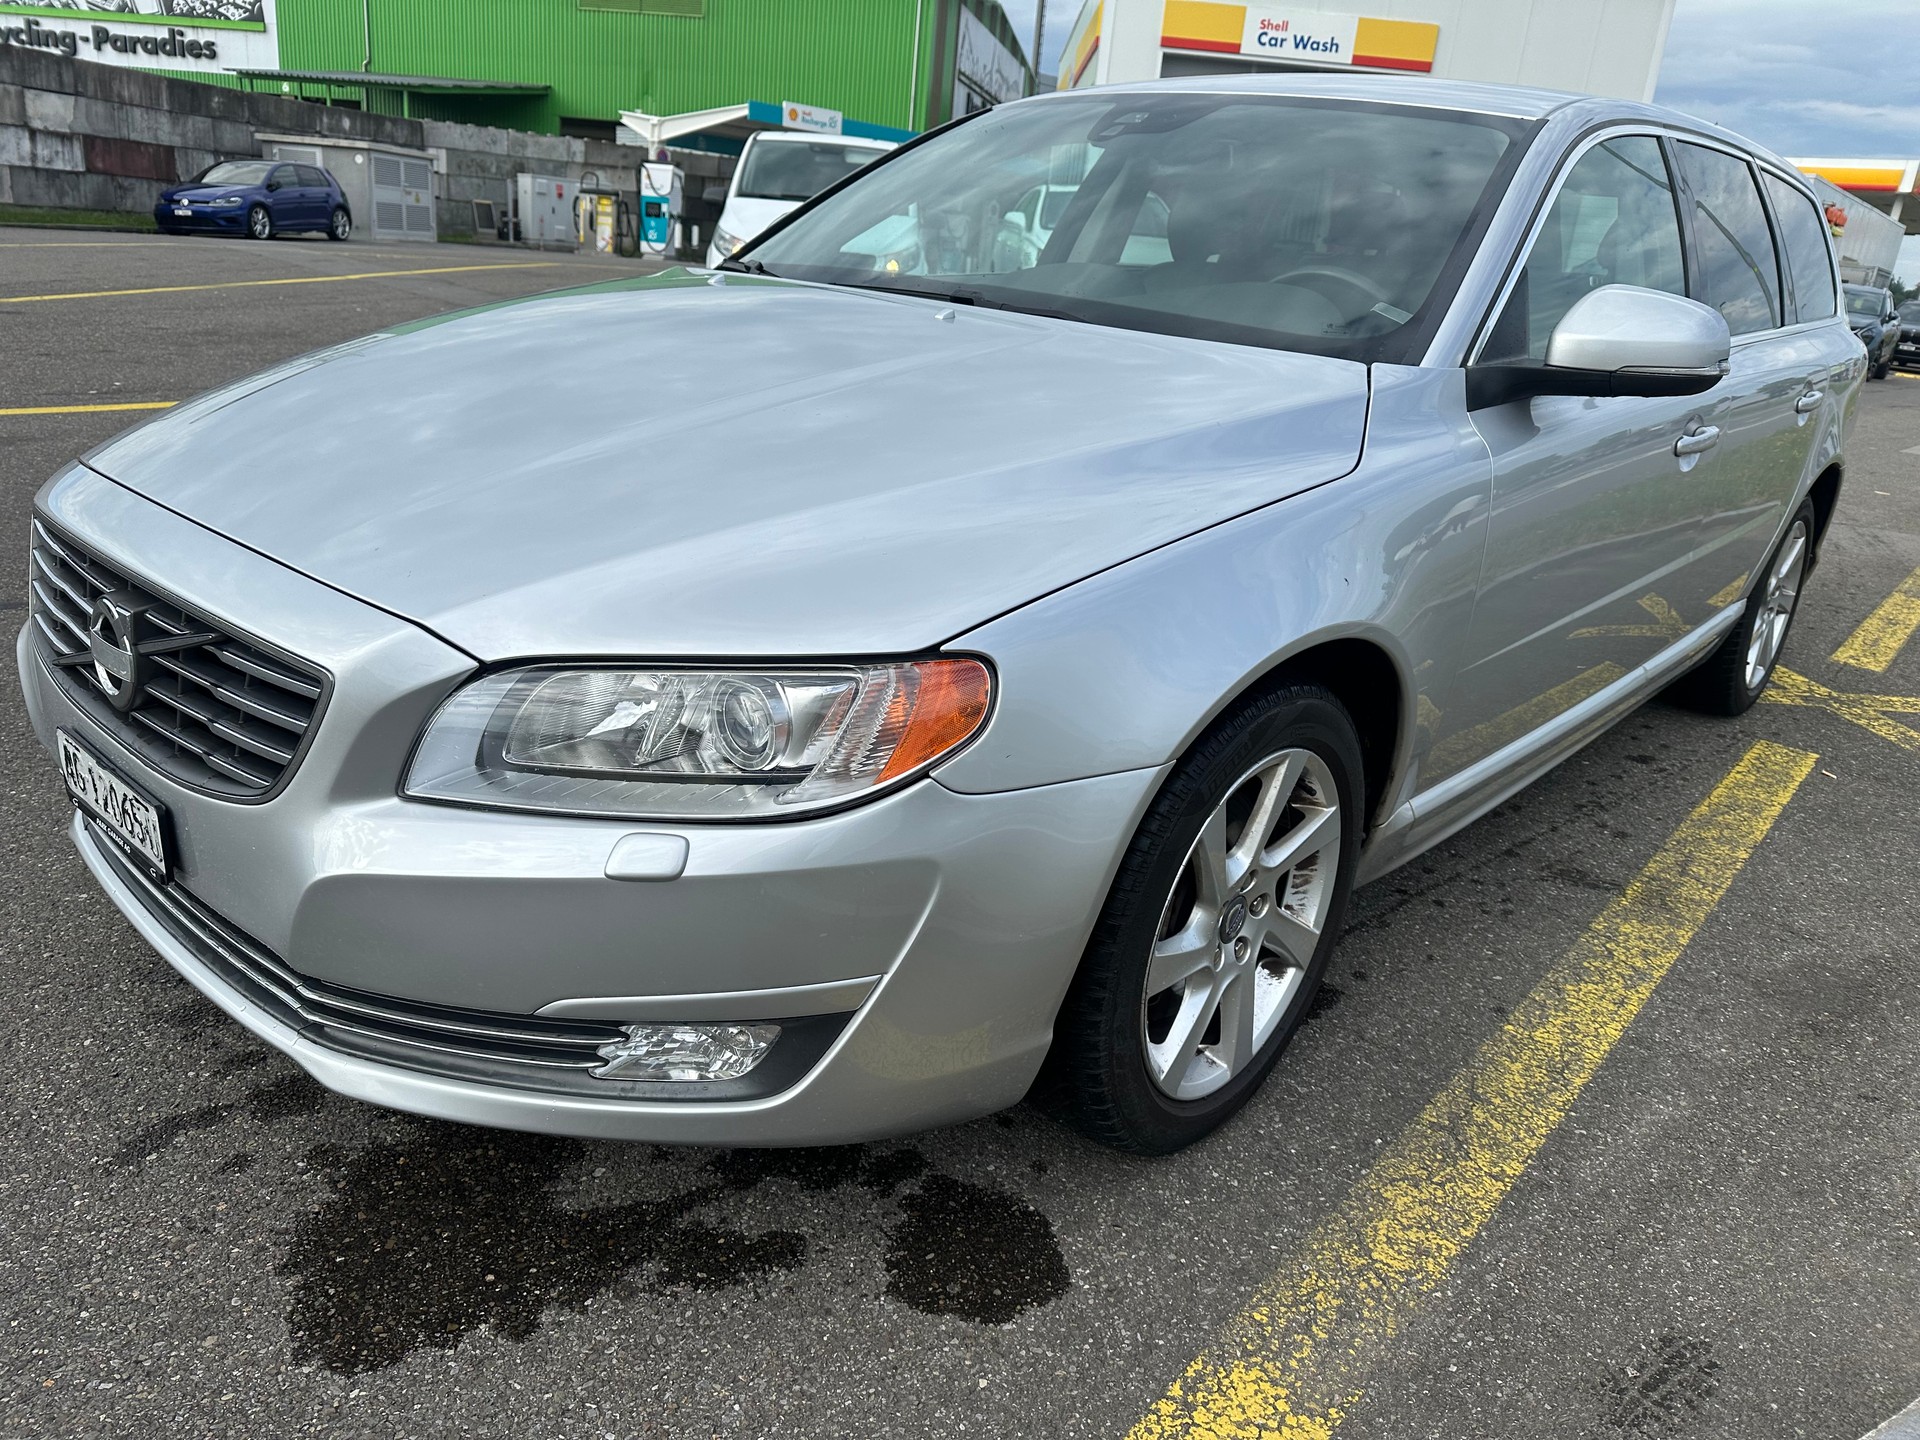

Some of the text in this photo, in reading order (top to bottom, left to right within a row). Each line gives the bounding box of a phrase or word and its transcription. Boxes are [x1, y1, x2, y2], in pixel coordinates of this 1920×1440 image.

[1259, 18, 1289, 32] Shell
[1257, 31, 1339, 53] Car Wash
[282, 81, 290, 92] 6
